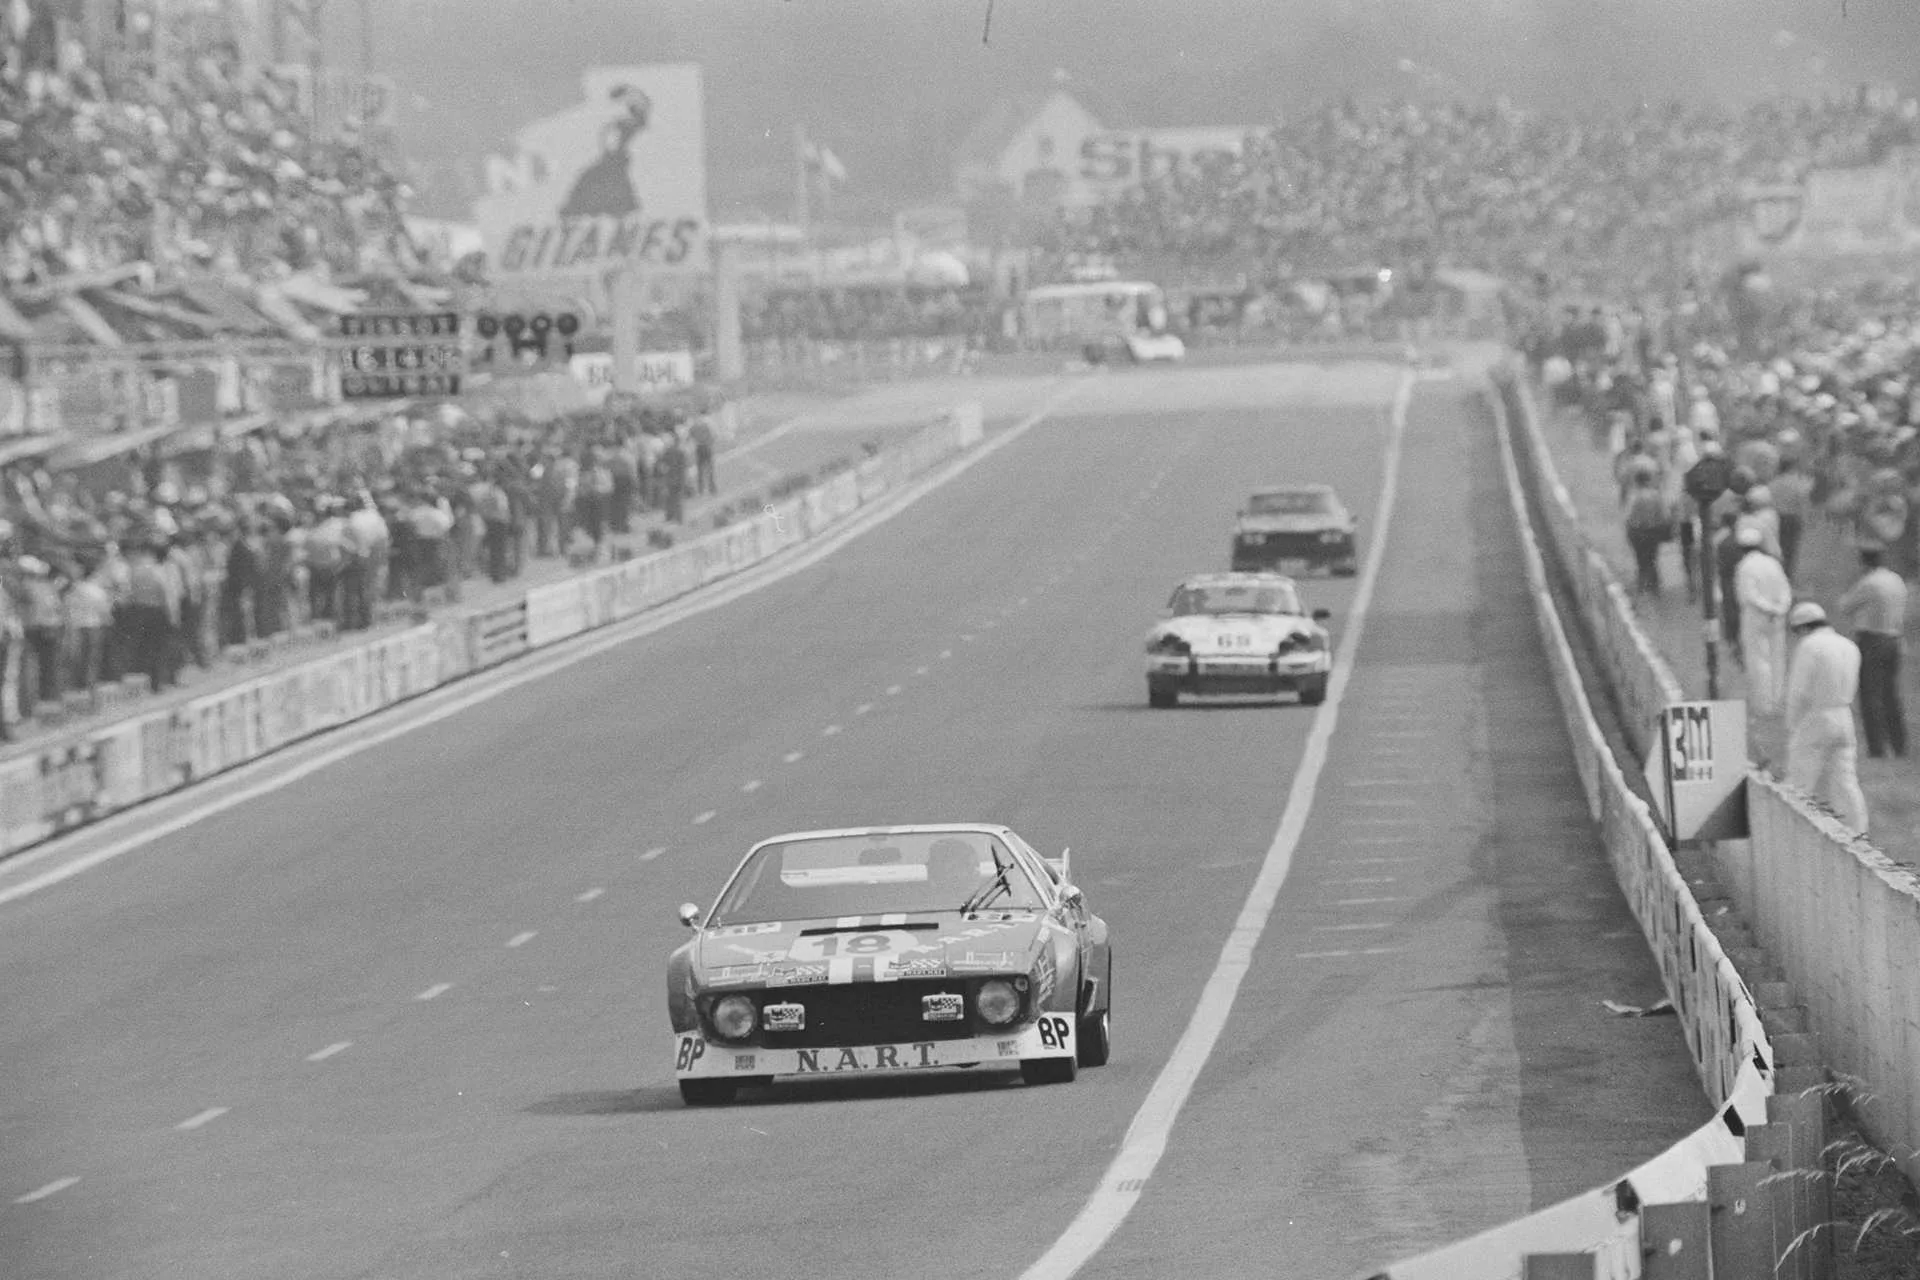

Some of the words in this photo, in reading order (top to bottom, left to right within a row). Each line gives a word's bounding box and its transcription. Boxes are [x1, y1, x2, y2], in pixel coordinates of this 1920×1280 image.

[501, 218, 698, 271] GITANES
[812, 933, 891, 957] 18
[1036, 1017, 1070, 1050] BP
[676, 1036, 706, 1071] BP
[796, 1042, 940, 1072] N.A.R.T.
